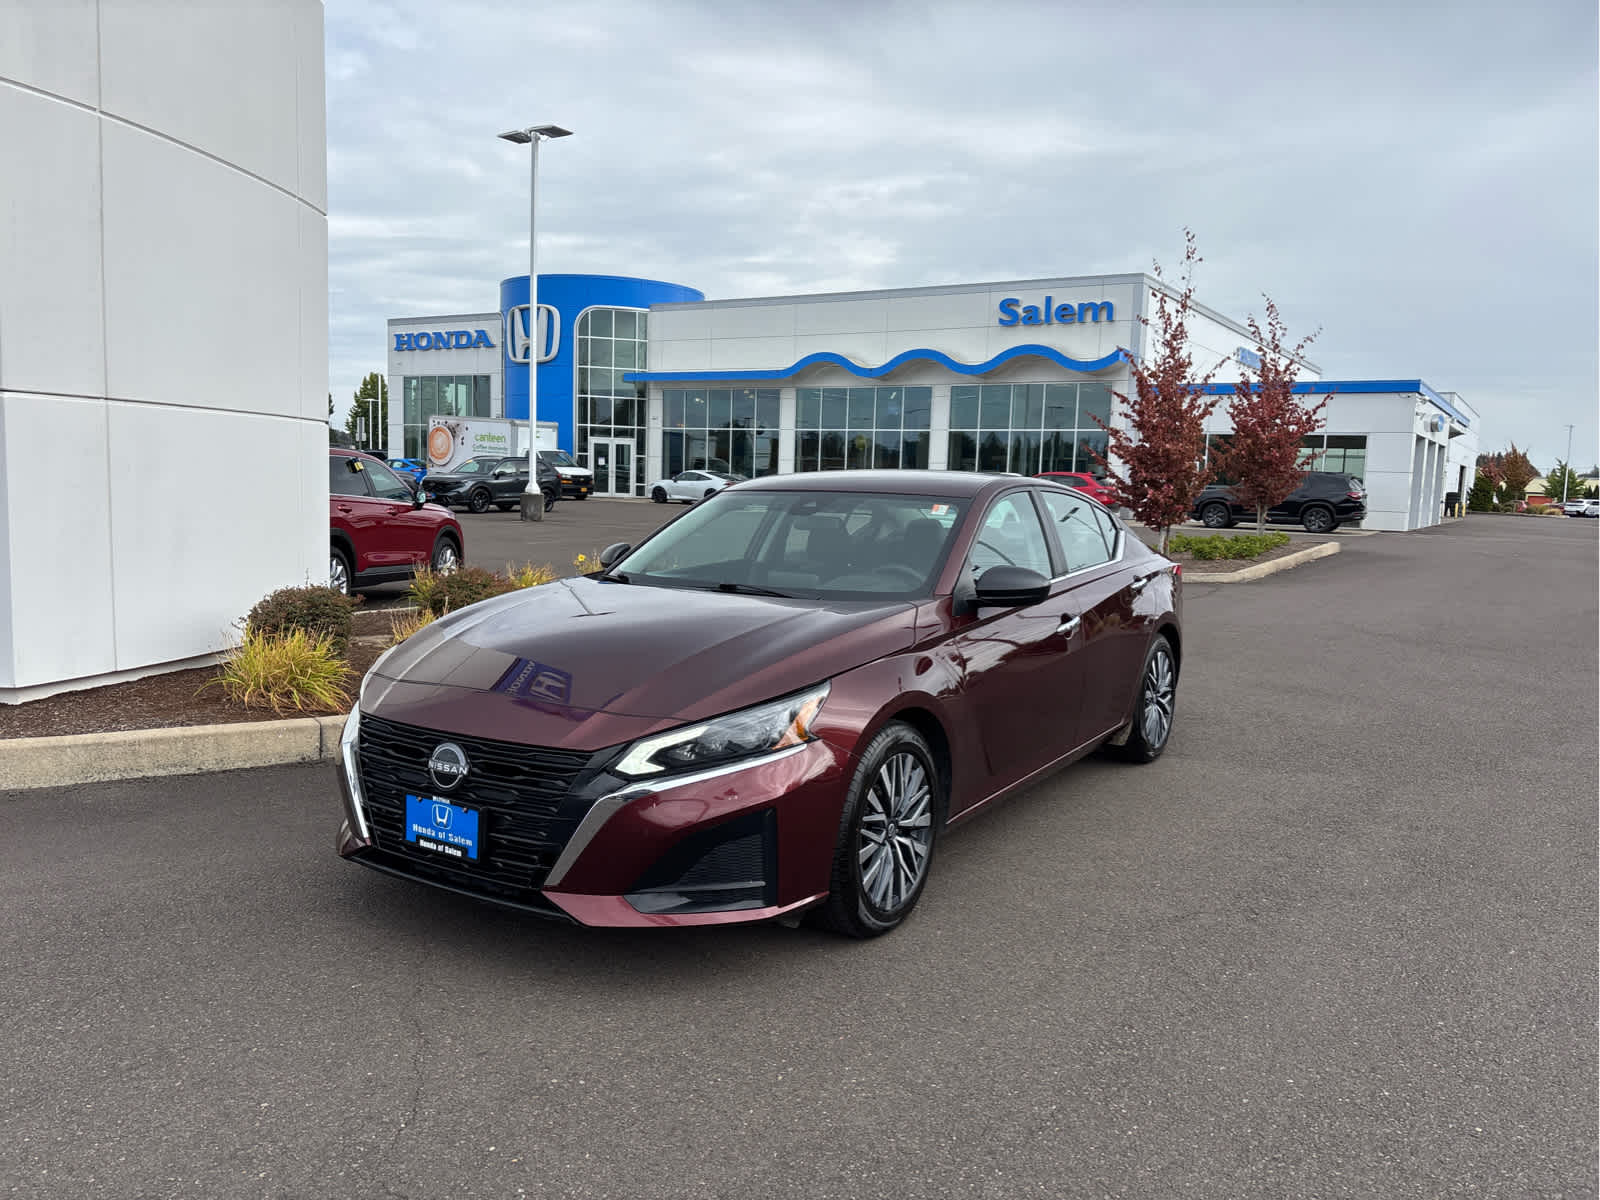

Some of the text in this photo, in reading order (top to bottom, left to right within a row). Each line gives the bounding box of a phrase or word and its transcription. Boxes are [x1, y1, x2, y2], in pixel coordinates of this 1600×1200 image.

[998, 296, 1114, 326] Salem
[394, 330, 496, 351] HONDA
[475, 432, 506, 442] canteen
[428, 760, 468, 774] NISSAN
[412, 823, 436, 836] Honda
[448, 833, 473, 847] Salem
[444, 846, 462, 857] Salem
